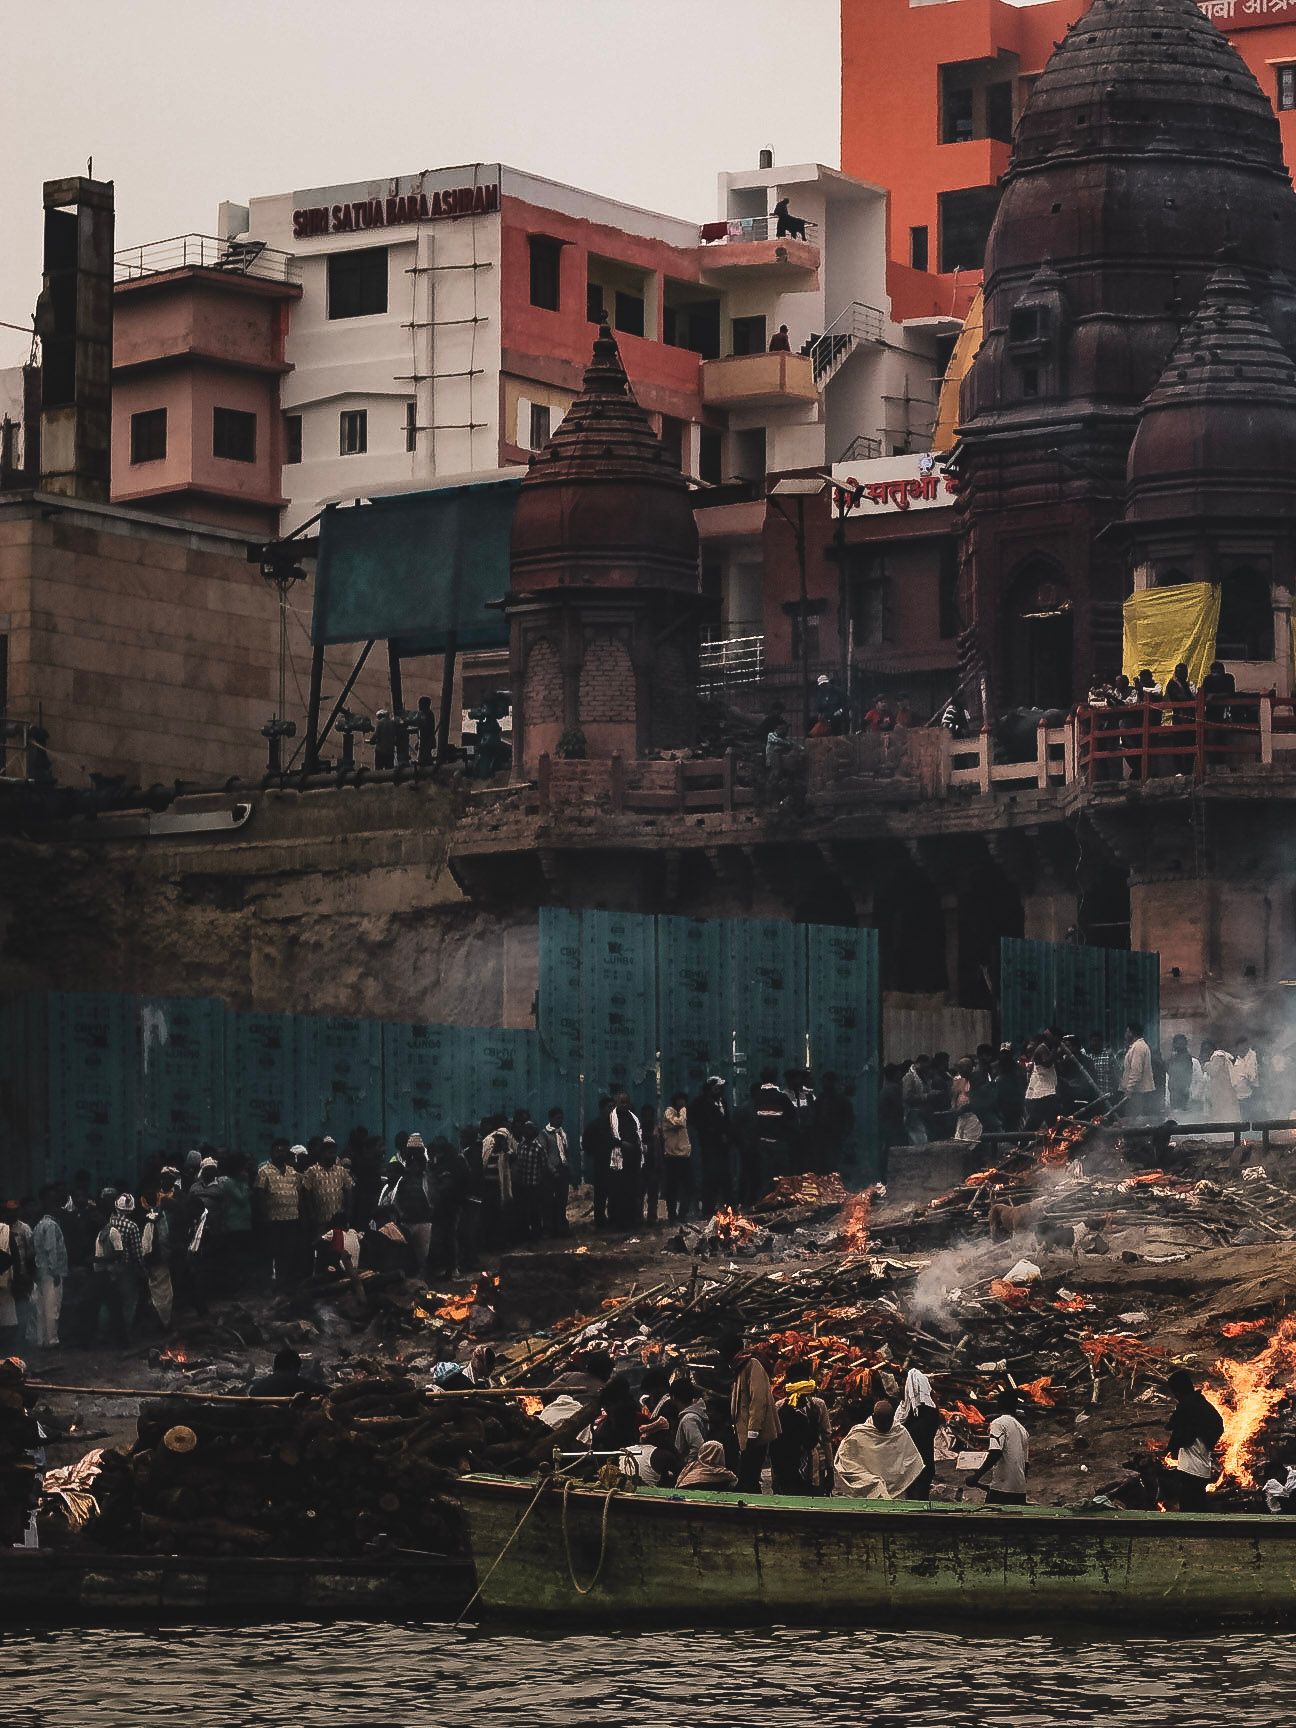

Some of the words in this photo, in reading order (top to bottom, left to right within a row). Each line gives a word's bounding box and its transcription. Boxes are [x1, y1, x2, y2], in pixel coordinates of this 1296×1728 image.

[293, 207, 329, 238] SHRI
[332, 199, 385, 232] SATUA
[386, 194, 429, 225] BABA
[431, 184, 498, 216] ASHRAM
